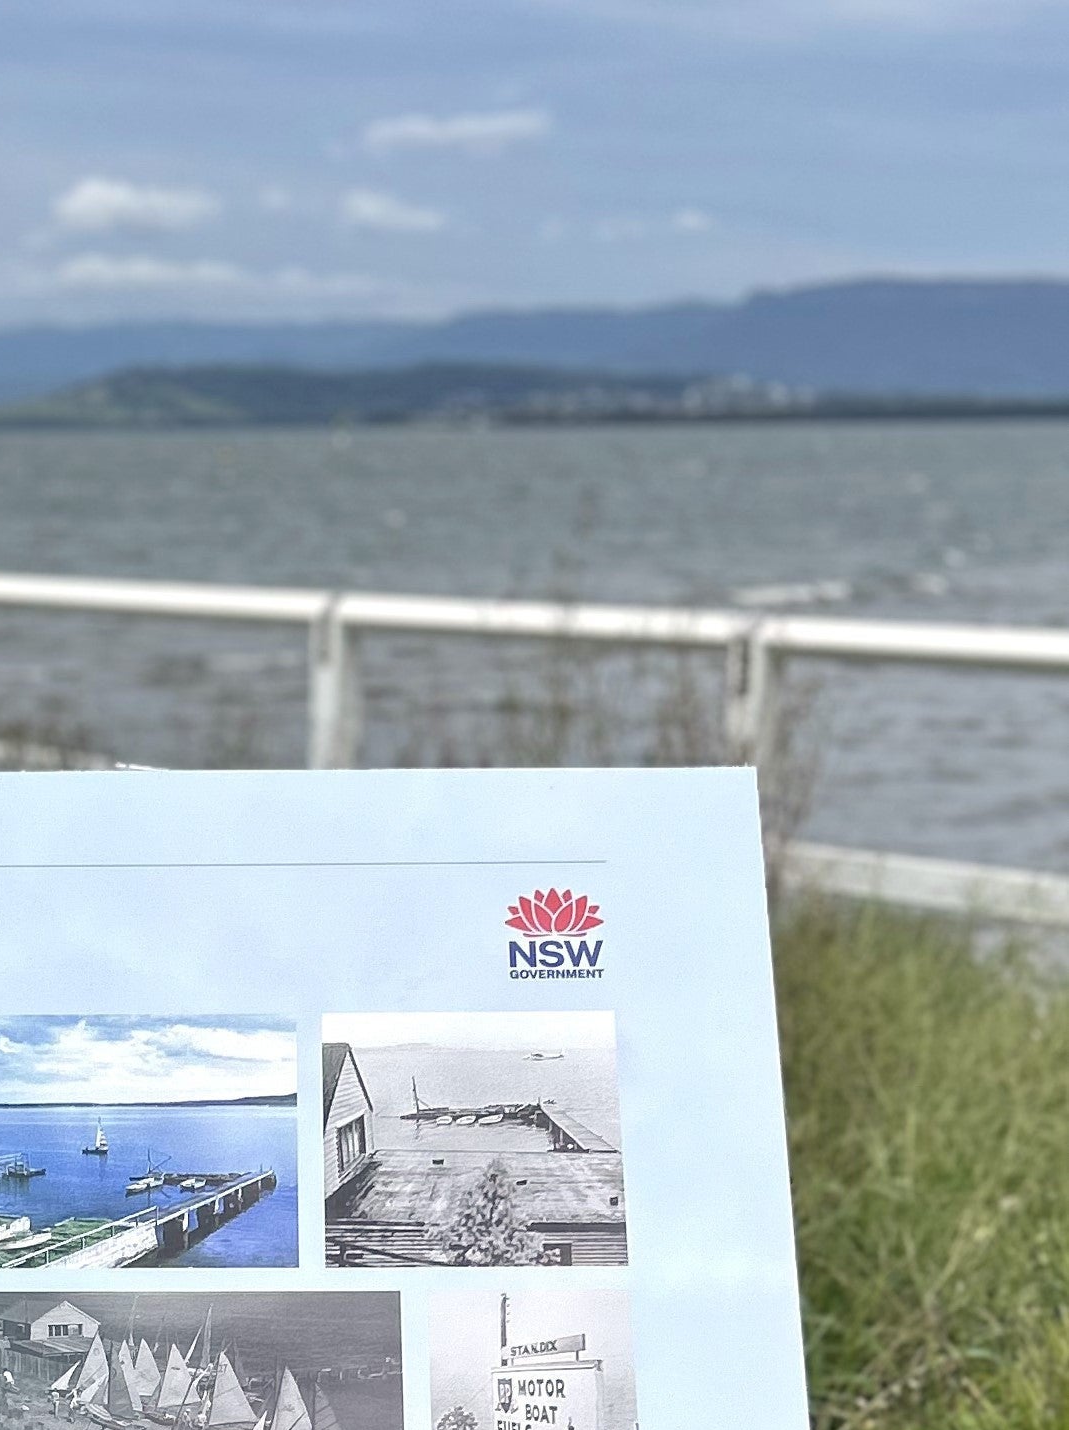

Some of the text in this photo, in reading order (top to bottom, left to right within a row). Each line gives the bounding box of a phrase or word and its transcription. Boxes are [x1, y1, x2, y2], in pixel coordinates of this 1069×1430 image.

[508, 940, 604, 968] NSW
[509, 968, 605, 979] GOVERNMENT
[517, 1378, 566, 1399] MOTOR
[525, 1403, 558, 1424] BOAT
